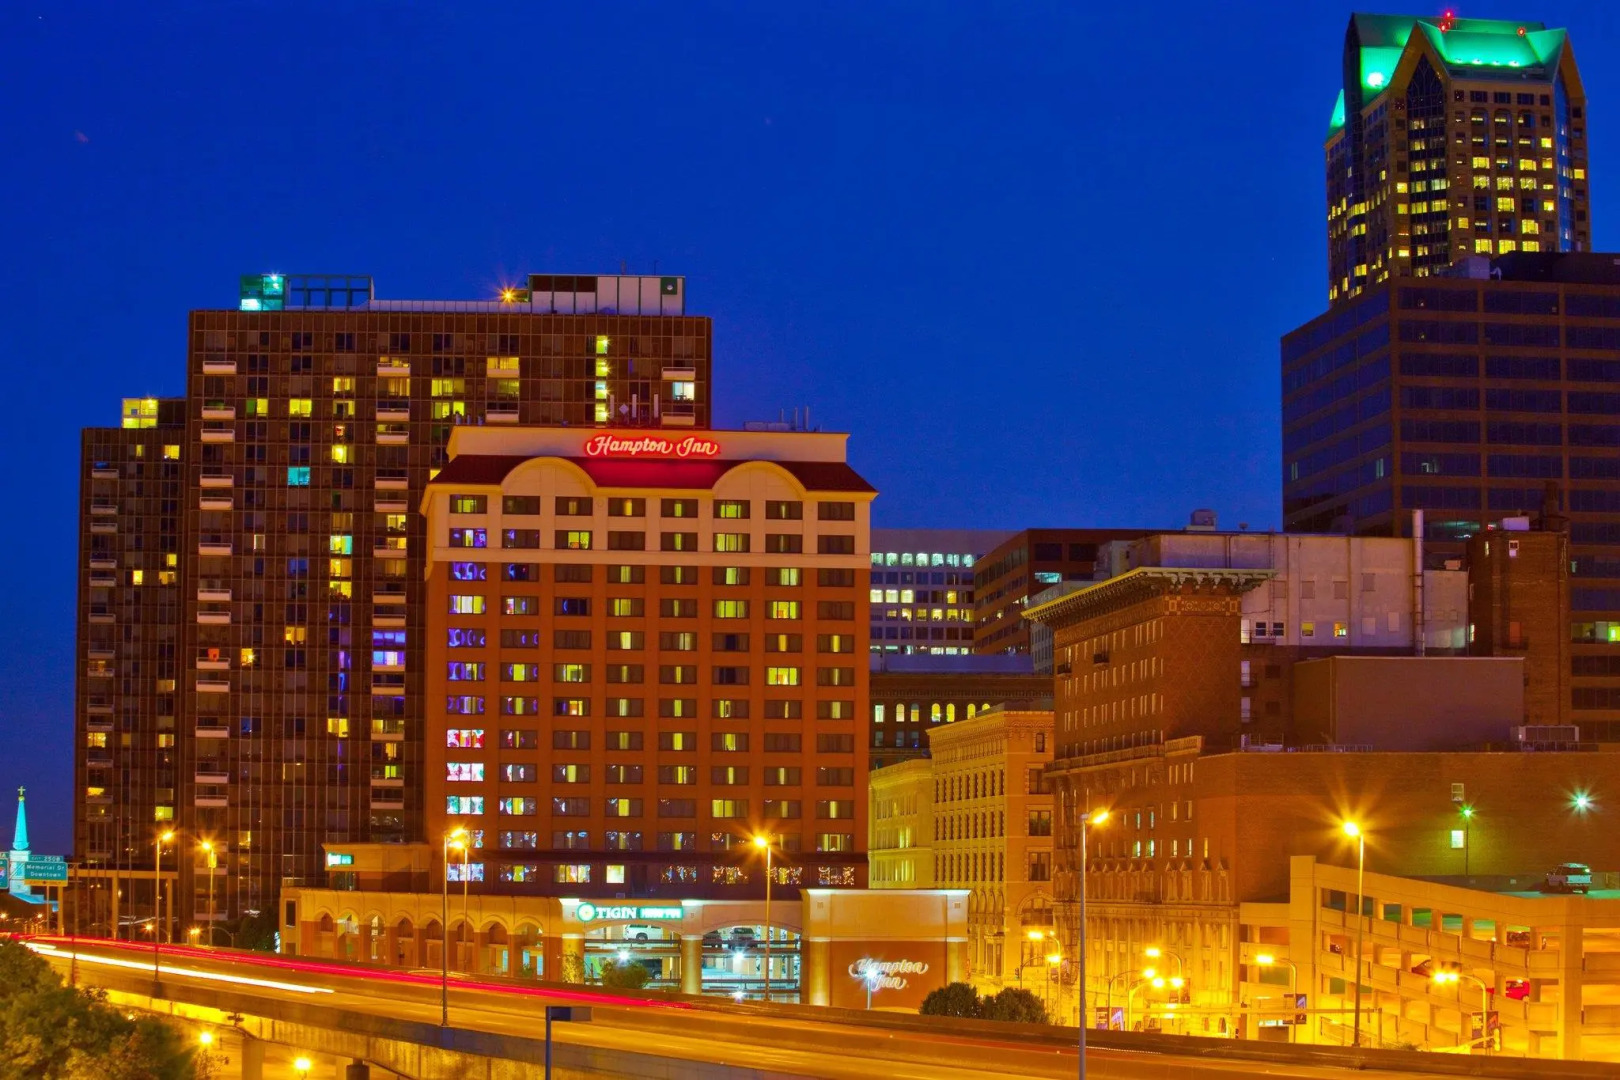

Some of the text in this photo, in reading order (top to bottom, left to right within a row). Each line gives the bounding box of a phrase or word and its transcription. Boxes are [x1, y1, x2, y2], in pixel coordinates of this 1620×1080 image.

[586, 435, 718, 457] Hampton Inn
[848, 958, 929, 977] Hampton
